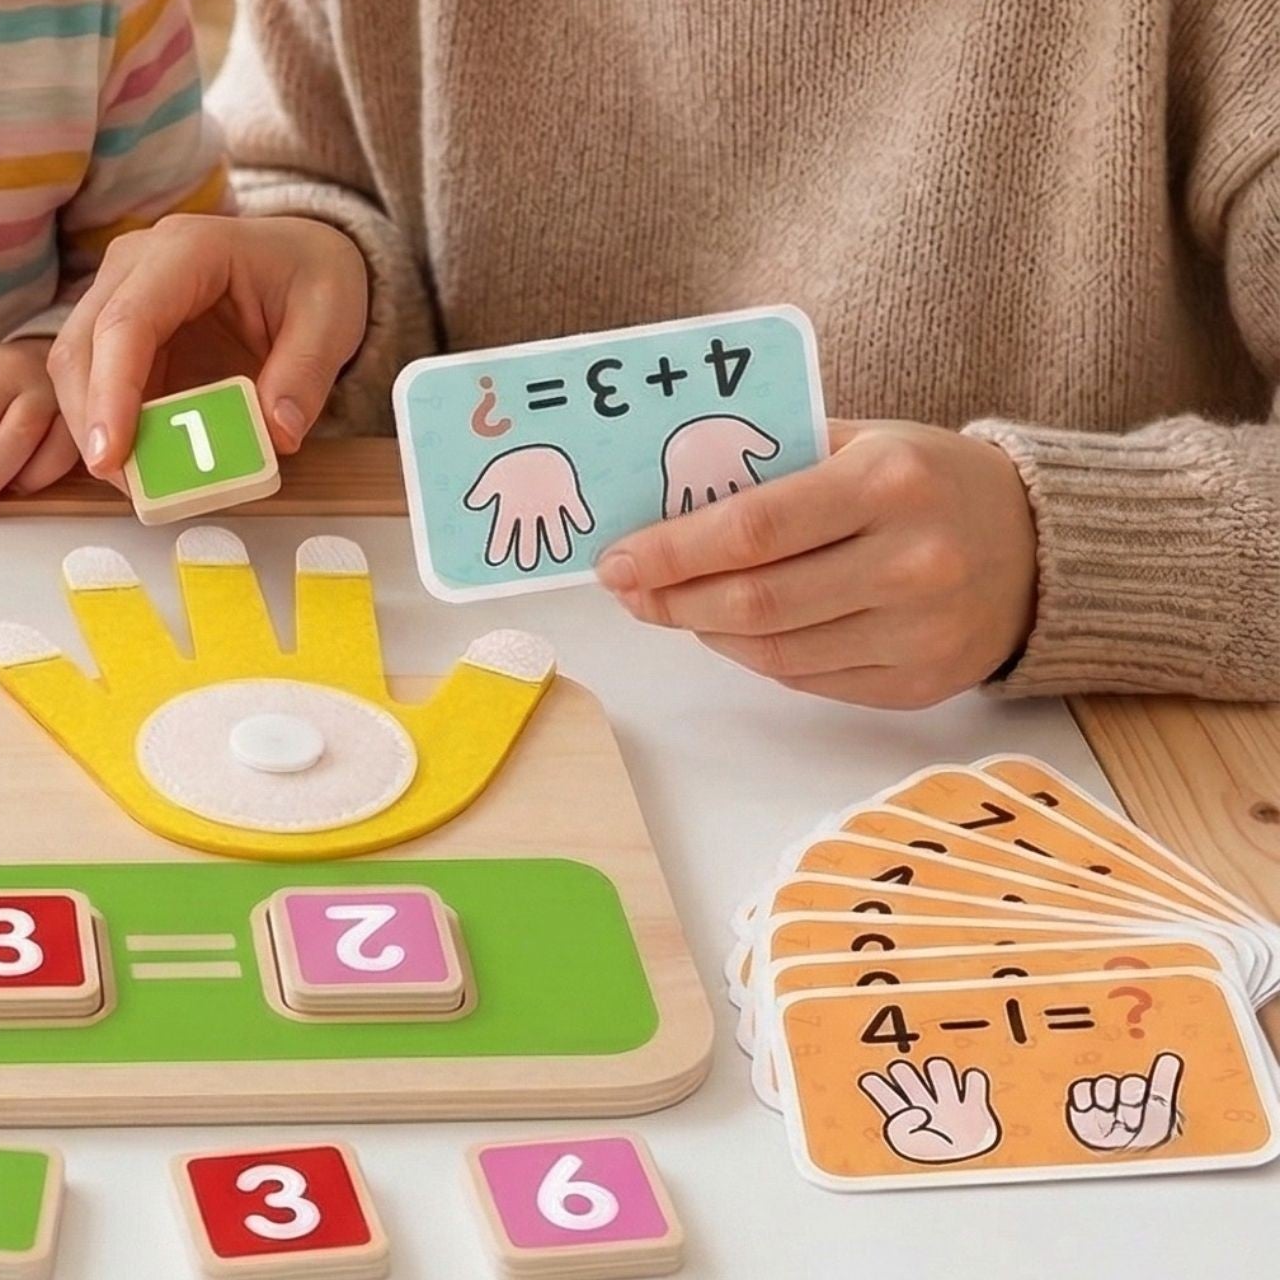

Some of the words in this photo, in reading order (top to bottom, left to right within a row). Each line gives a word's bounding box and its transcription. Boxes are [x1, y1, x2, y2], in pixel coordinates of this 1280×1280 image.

[526, 378, 569, 411] =
[586, 358, 631, 418] 3
[645, 356, 689, 398] +
[704, 338, 752, 398] 4
[470, 376, 512, 439] ?
[170, 409, 215, 472] 1
[324, 903, 407, 972] 2
[860, 1004, 920, 1054] 4
[1005, 997, 1028, 1044] 1
[1043, 1006, 1096, 1030] =
[1106, 985, 1153, 1040] ?
[234, 1163, 322, 1241] 3
[534, 1152, 621, 1231] 6
